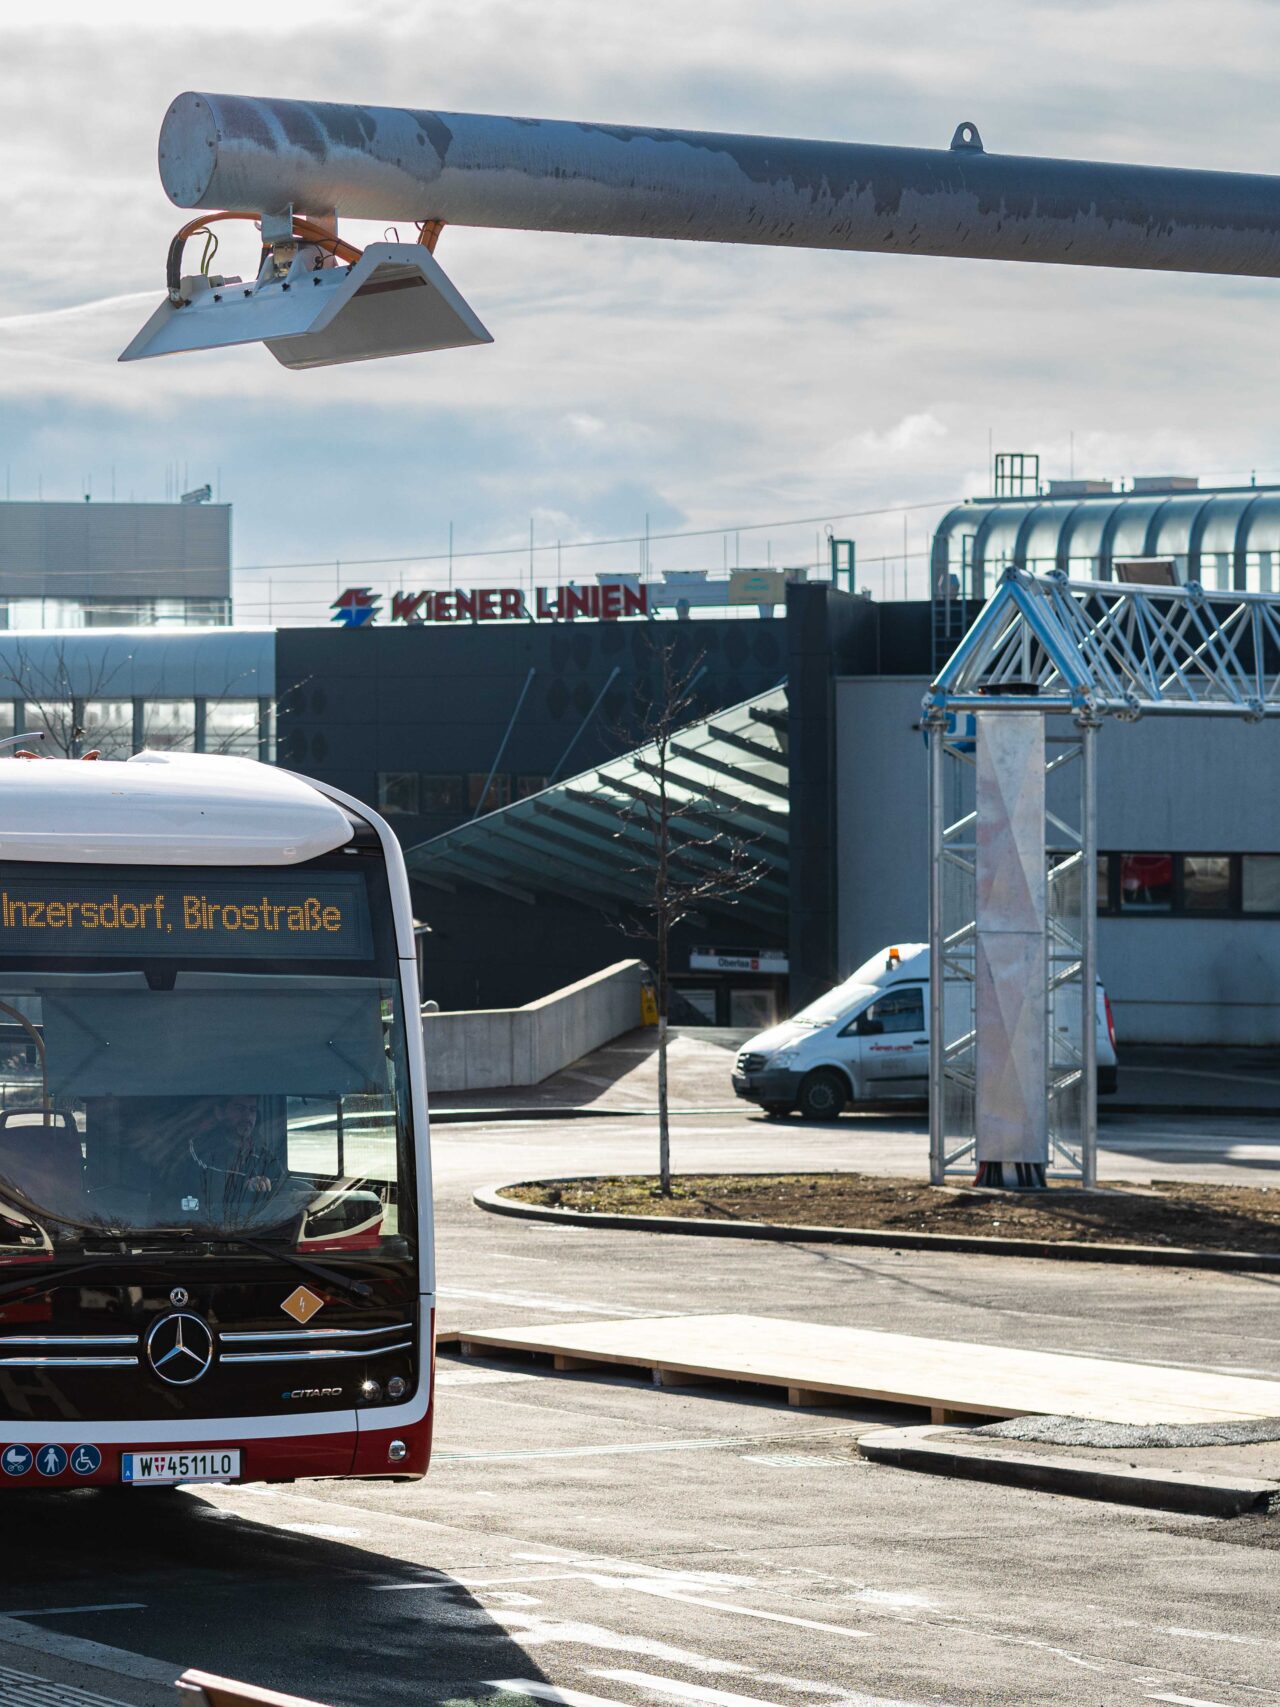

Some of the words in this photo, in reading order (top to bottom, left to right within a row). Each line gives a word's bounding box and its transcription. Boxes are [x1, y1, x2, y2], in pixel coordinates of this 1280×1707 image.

[391, 588, 525, 622] WIENER
[535, 584, 648, 620] LINIEN
[2, 892, 172, 933] Inzersdorf,
[183, 896, 342, 931] Birostraße
[281, 1387, 343, 1399] eCITARO
[140, 1457, 153, 1477] W
